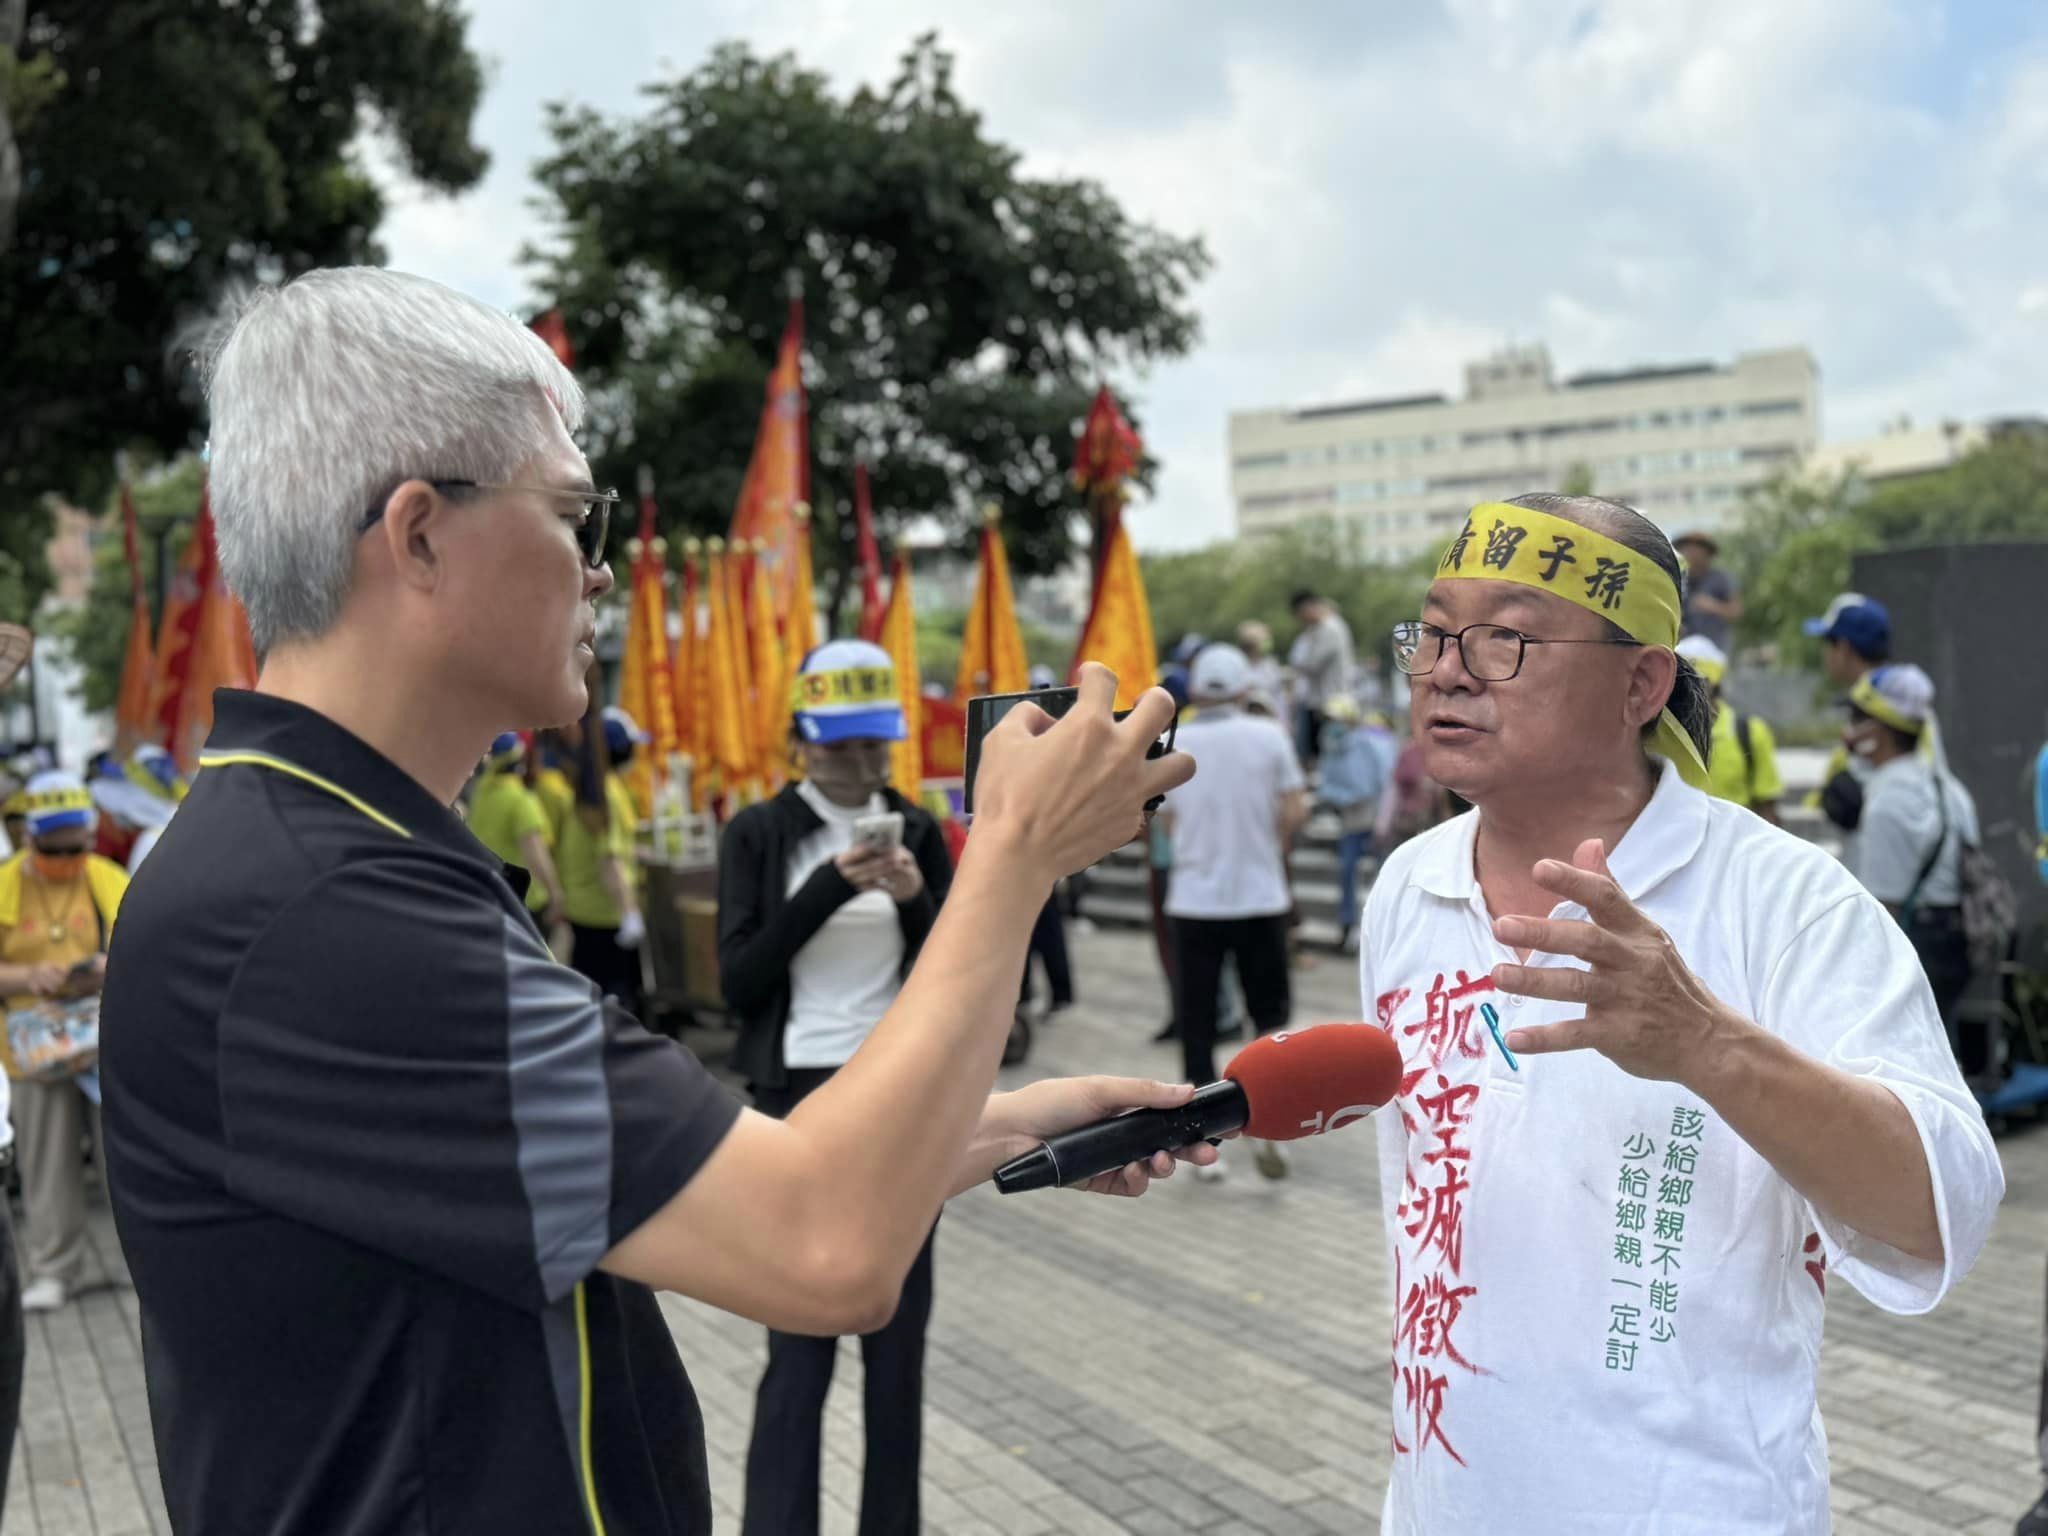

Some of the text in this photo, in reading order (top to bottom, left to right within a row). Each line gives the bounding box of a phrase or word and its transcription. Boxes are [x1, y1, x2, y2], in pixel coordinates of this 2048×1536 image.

[1605, 1132, 1655, 1372] 少給鄉親一定討
[1649, 1106, 1706, 1344] 該給鄉親不能少
